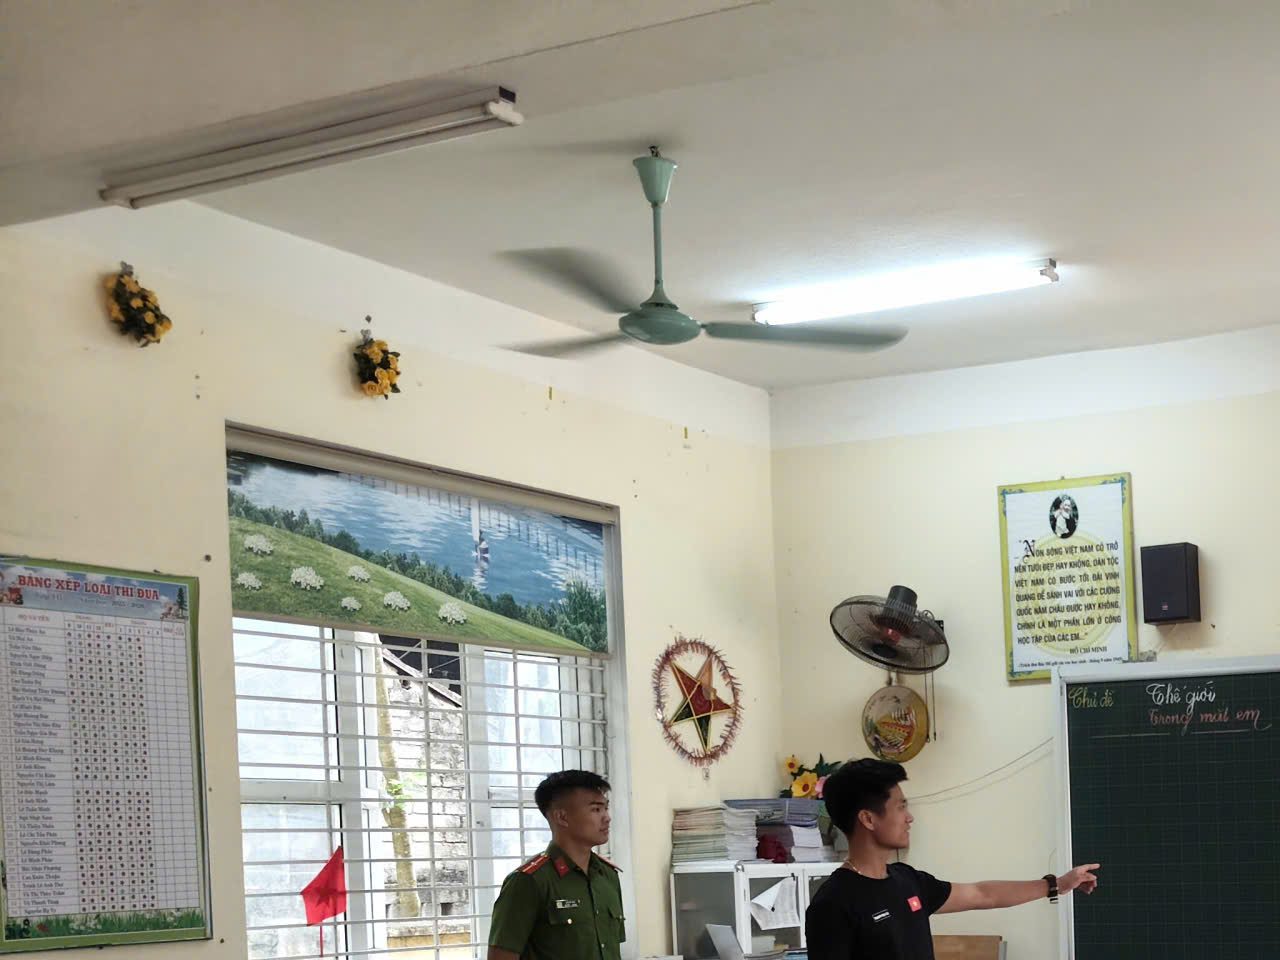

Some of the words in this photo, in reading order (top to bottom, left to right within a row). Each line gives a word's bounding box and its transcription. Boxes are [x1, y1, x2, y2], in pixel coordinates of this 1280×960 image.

[1079, 545, 1094, 554] NAM
[1055, 561, 1068, 570] HAY
[1031, 578, 1044, 586] NAM
[1105, 572, 1120, 581] VINH
[18, 573, 52, 589] BẢNG
[54, 577, 81, 592] XẾP
[114, 585, 134, 598] THI
[137, 588, 160, 600] ĐUA
[1016, 593, 1036, 602] QUANG
[1064, 589, 1073, 598] VAI
[1084, 602, 1096, 611] HAY
[1146, 682, 1187, 706] Thế
